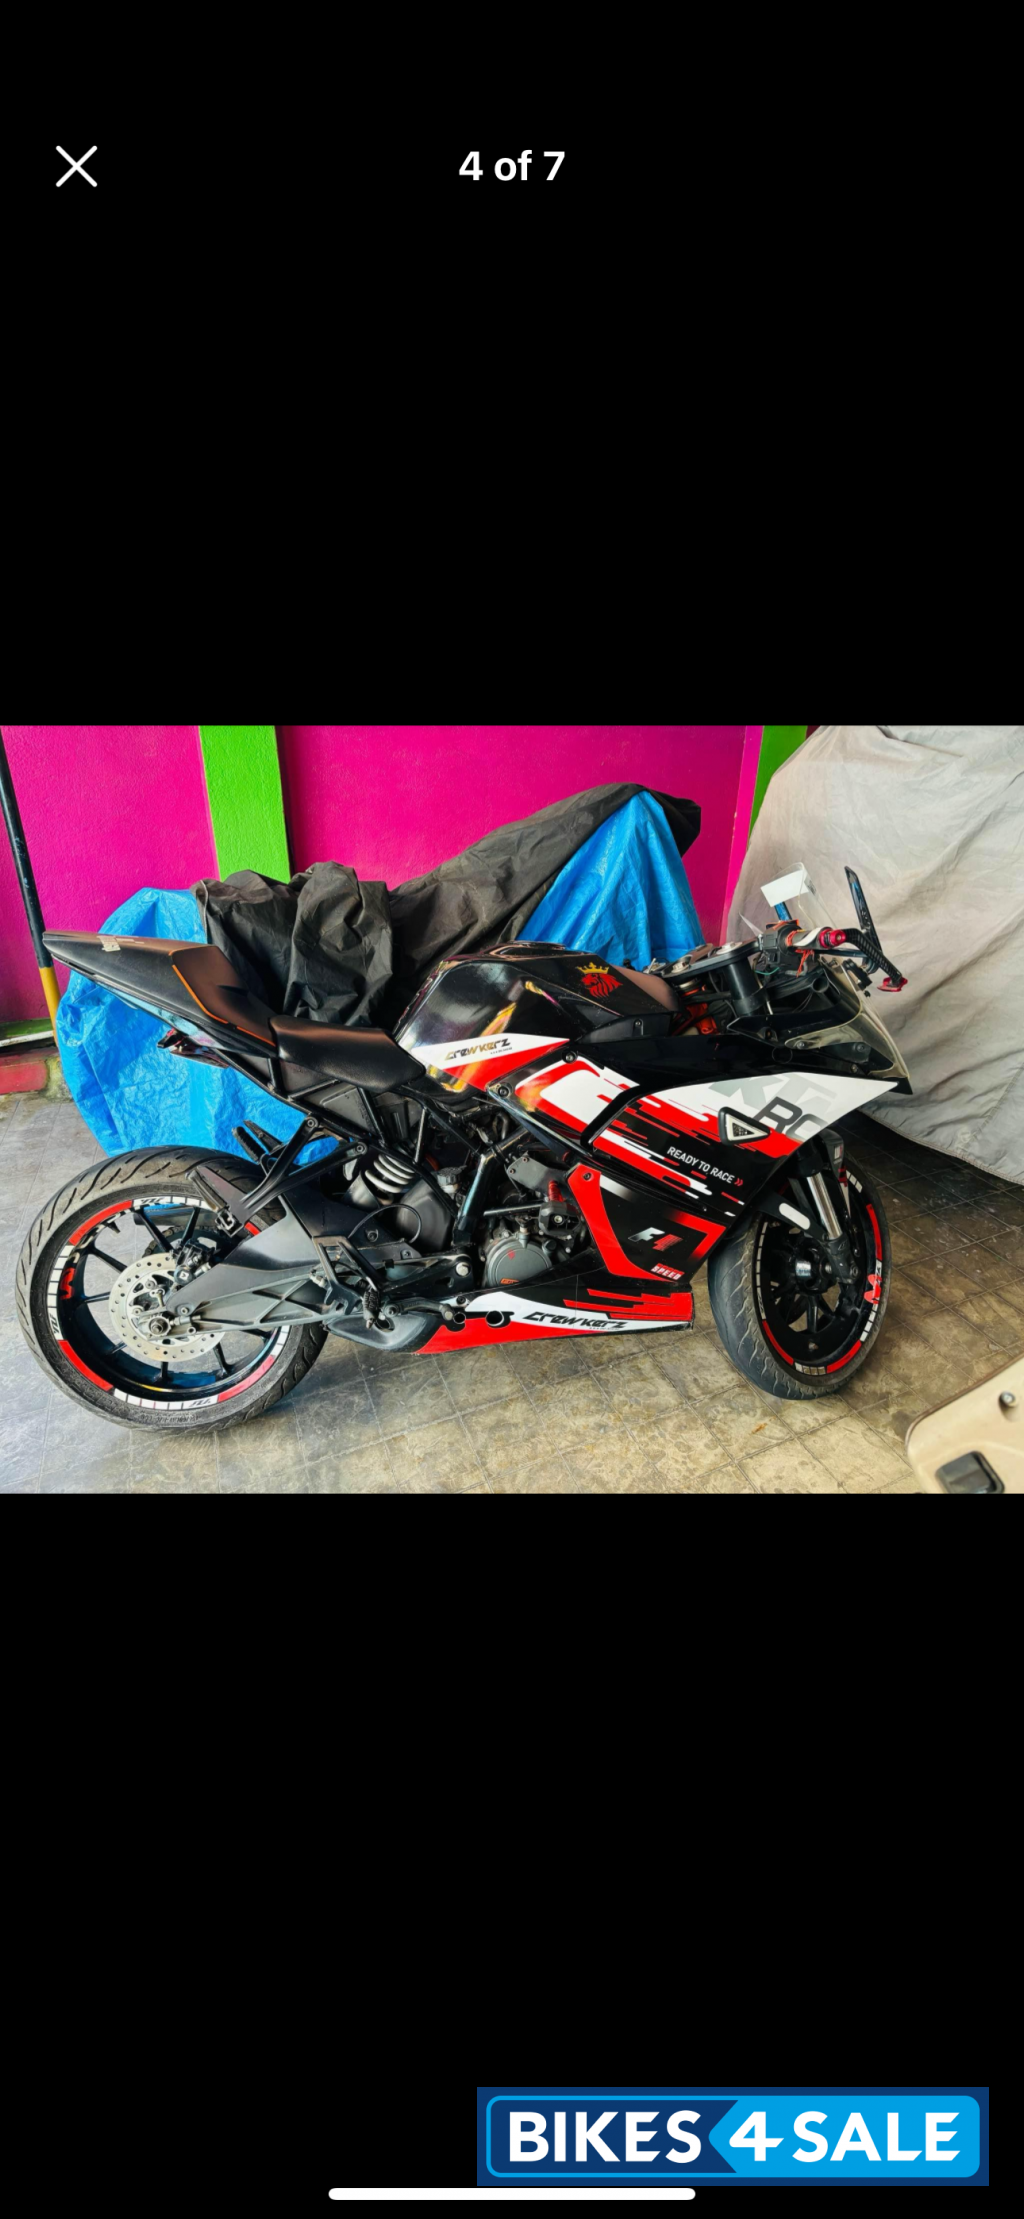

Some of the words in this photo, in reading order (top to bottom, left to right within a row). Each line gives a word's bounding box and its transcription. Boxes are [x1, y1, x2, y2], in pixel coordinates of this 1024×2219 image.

[666, 1146, 699, 1168] READY
[697, 1159, 710, 1173] TO
[710, 1167, 735, 1184] RACE
[651, 1263, 684, 1280] SPEED
